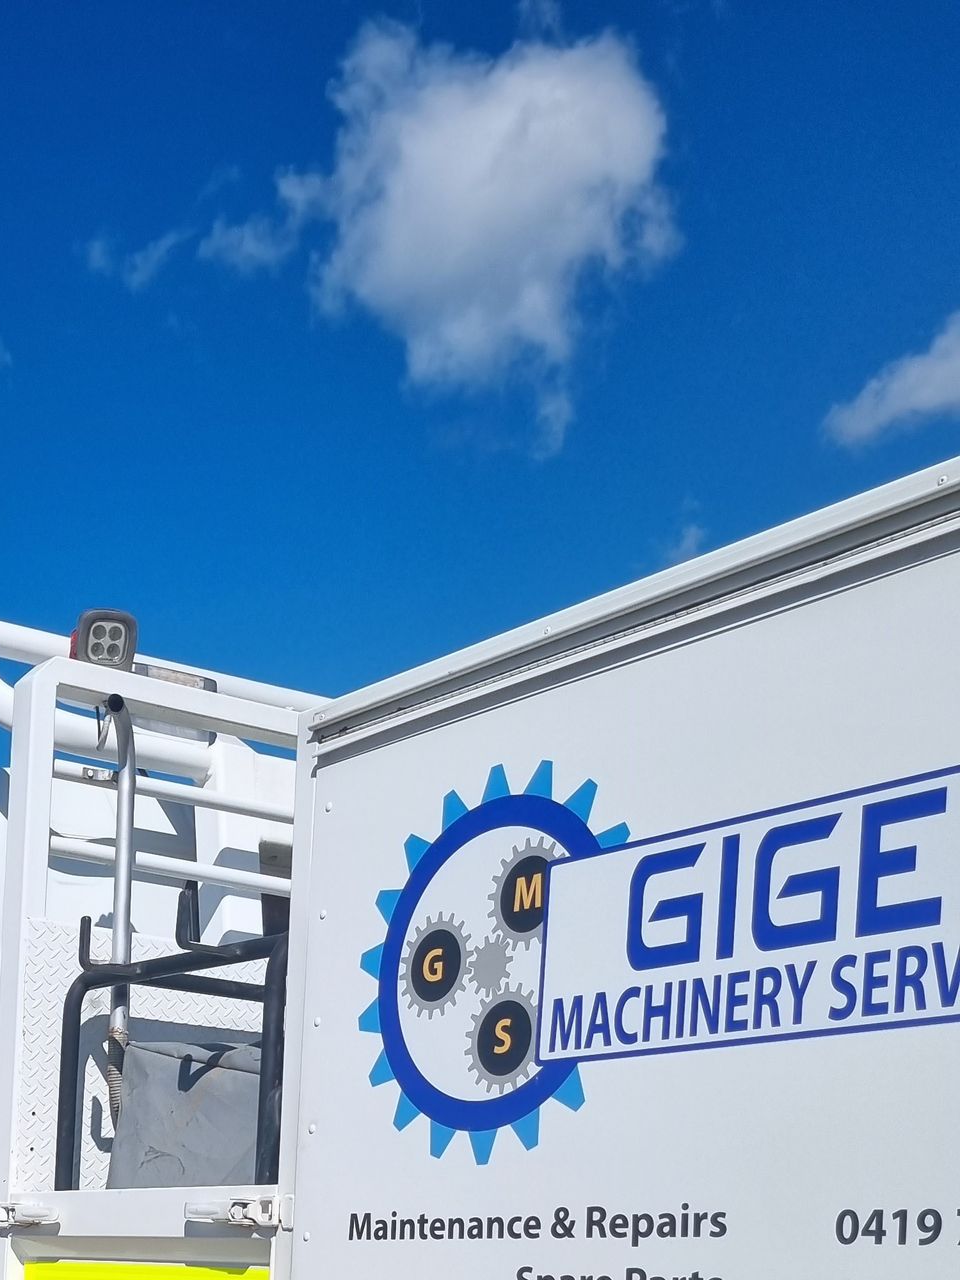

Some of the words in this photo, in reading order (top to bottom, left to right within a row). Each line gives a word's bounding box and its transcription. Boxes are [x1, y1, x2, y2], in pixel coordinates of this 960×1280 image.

[513, 873, 543, 912] M
[627, 787, 948, 971] GIGE
[422, 948, 444, 982] G
[548, 963, 816, 1053] MACHINERY
[493, 1018, 512, 1054] S
[348, 1210, 542, 1241] Maintenance
[550, 1206, 576, 1239] &
[585, 1202, 728, 1248] Repairs
[835, 1208, 943, 1246] 0419
